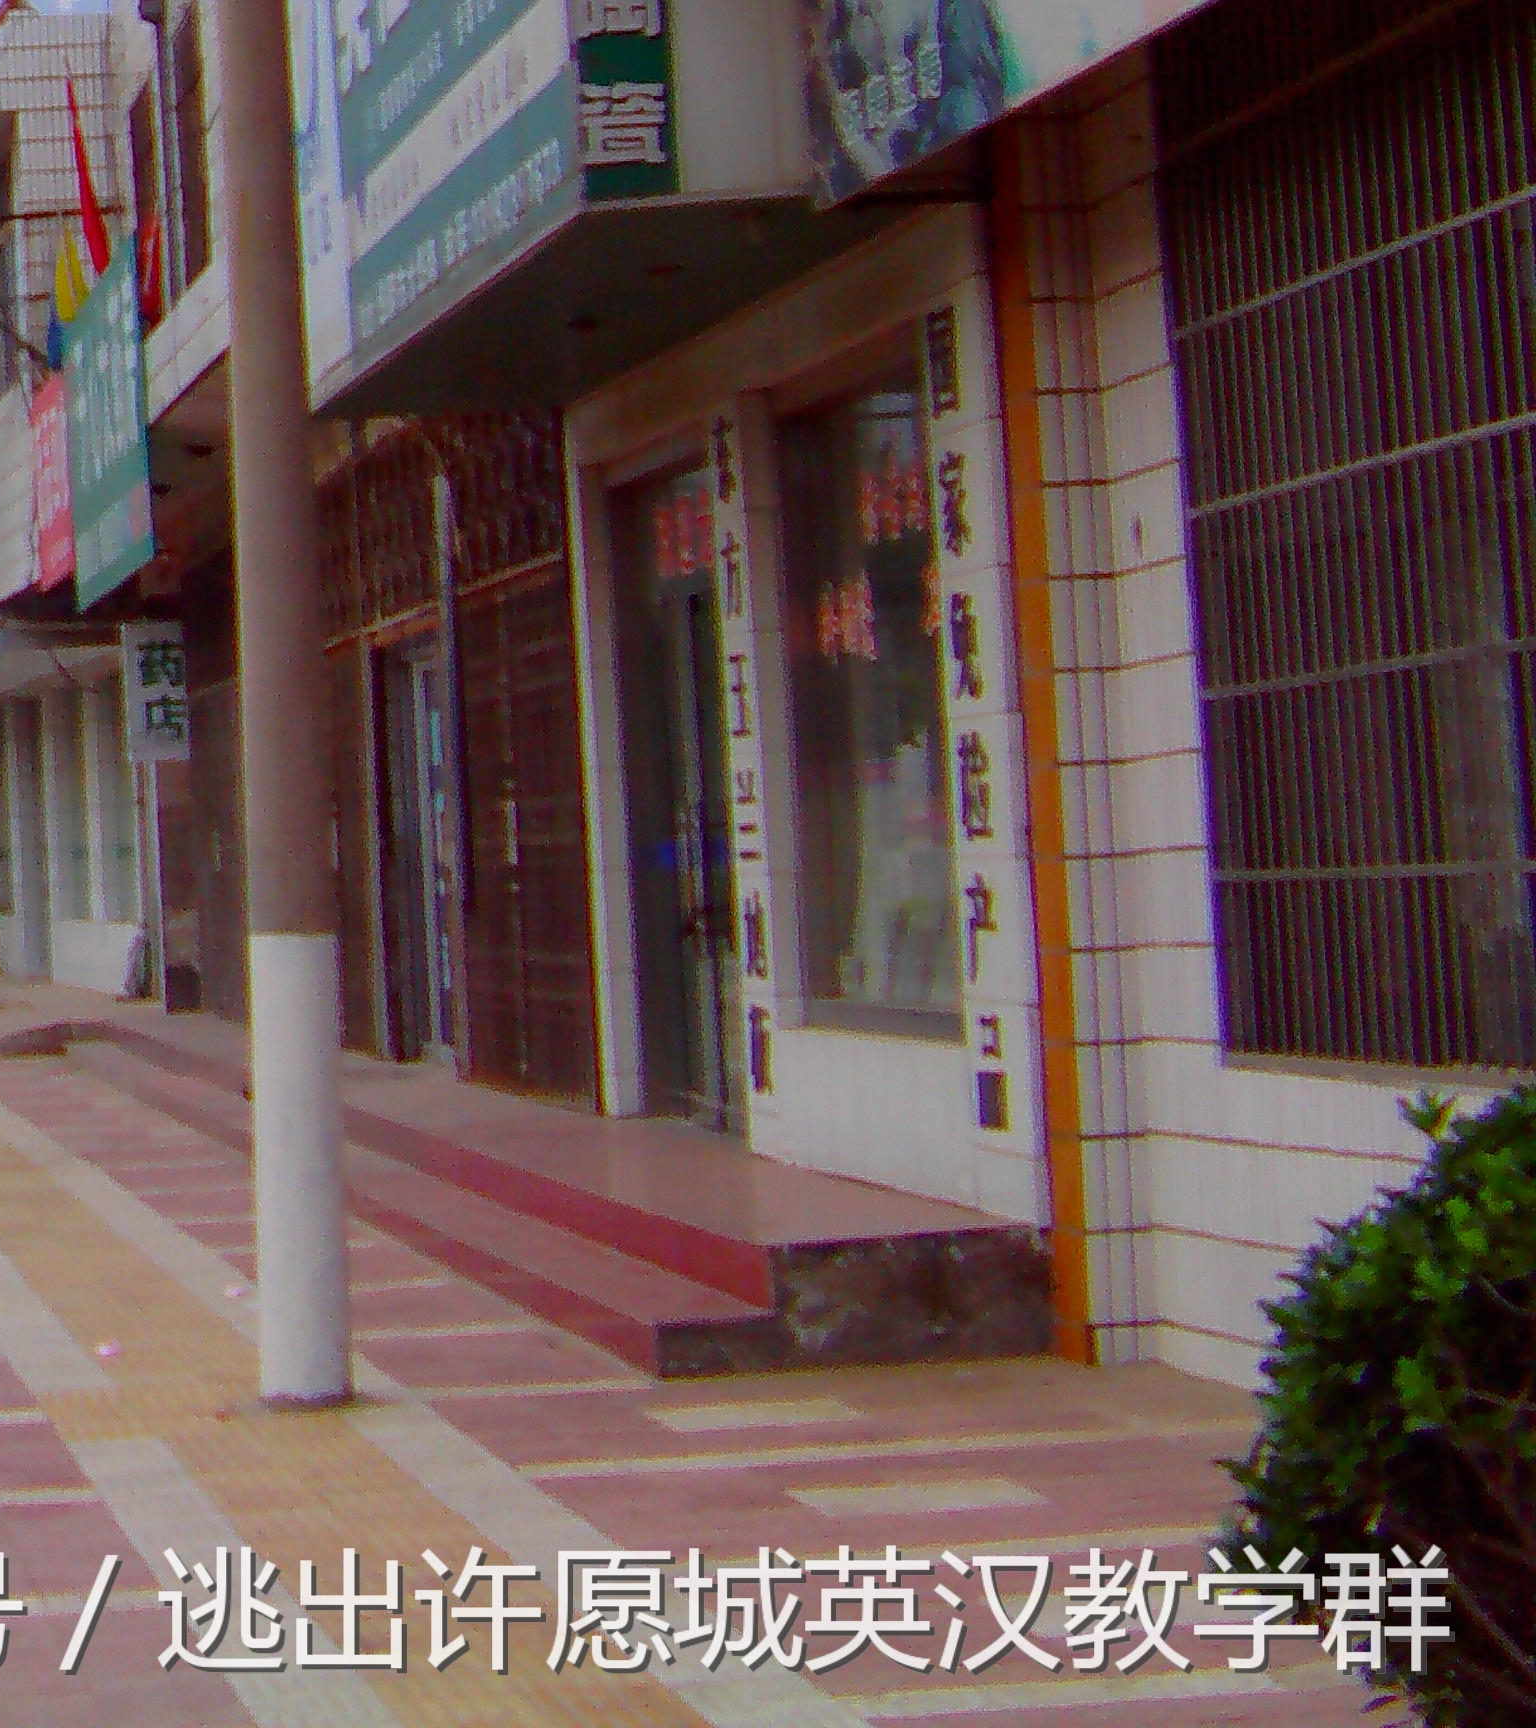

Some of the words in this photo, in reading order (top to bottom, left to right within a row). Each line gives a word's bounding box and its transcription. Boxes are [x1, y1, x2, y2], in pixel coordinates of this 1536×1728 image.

[134, 638, 185, 744] 药店
[926, 302, 1010, 1132] 国家免检产品
